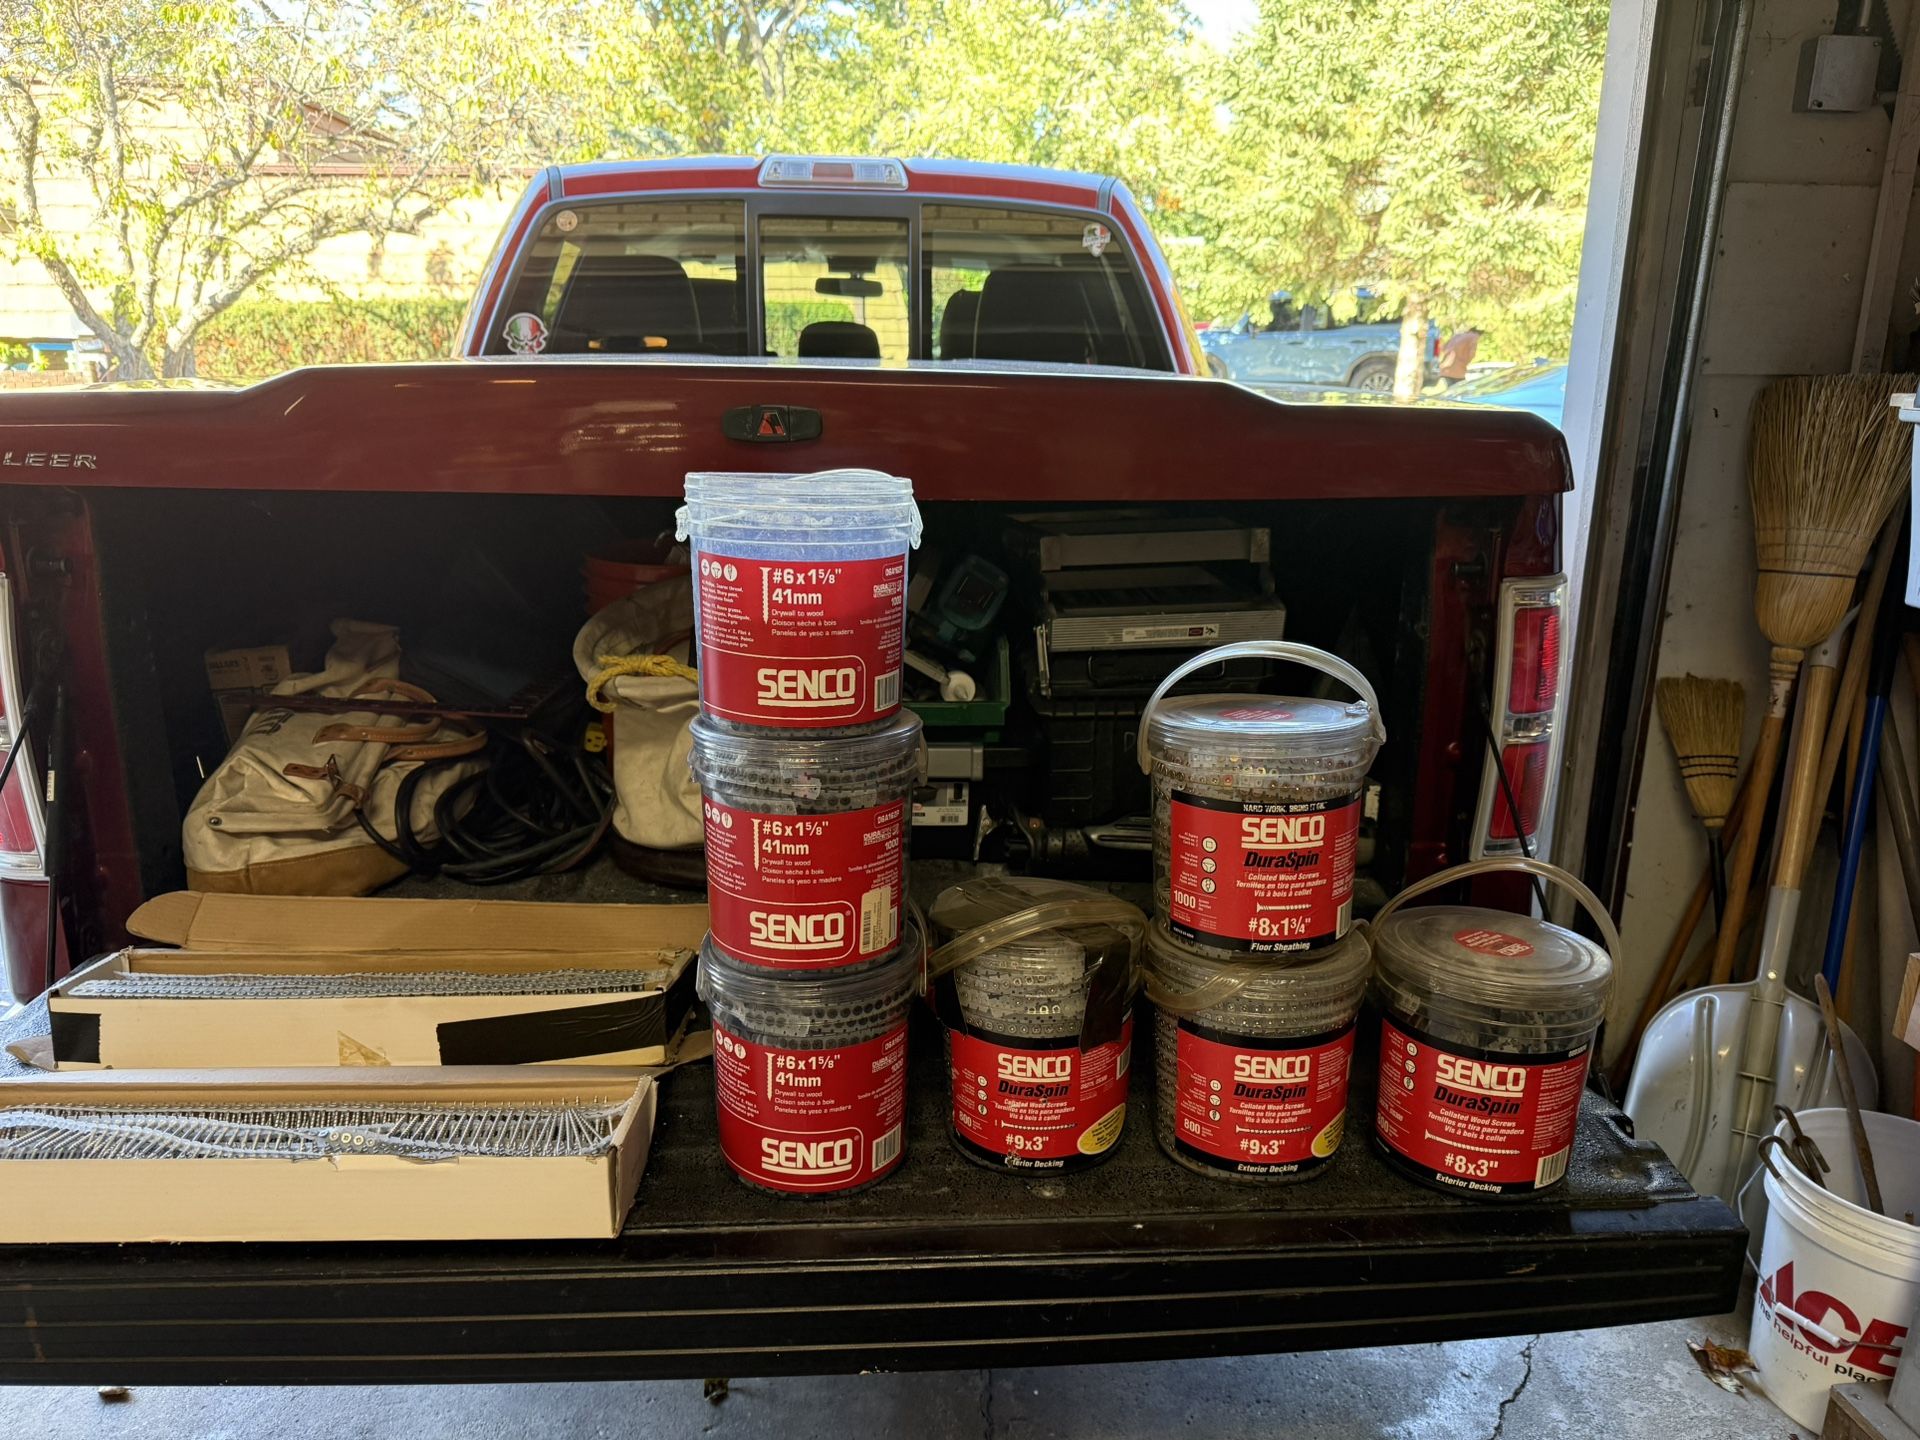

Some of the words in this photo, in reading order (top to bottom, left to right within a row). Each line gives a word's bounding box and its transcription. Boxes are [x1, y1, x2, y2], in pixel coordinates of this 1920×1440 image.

[3, 452, 97, 469] LEER
[772, 588, 823, 604] 41mm
[771, 609, 796, 617] Drywall
[771, 618, 795, 626] Cloison
[771, 629, 798, 637] Paneles
[757, 668, 856, 700] SENCO
[1241, 815, 1325, 844] SENCO
[762, 839, 810, 855] 41mm
[885, 837, 899, 851] 1000
[761, 857, 785, 866] Drywall
[1243, 851, 1320, 871] DuraSpin
[761, 866, 784, 875] Cloison
[1247, 872, 1278, 881] Collated
[1279, 873, 1297, 881] Wood
[1298, 872, 1320, 880] Screws
[761, 875, 786, 885] Paneles
[818, 876, 843, 884] madera
[1236, 880, 1266, 889] Tornillos
[1290, 882, 1305, 891] para
[1305, 879, 1327, 888] madera
[1173, 889, 1196, 909] 1000
[1254, 890, 1265, 898] Vis
[1266, 889, 1272, 897] à
[1272, 889, 1287, 898] bois
[1288, 889, 1294, 898] à
[1295, 888, 1313, 896] collet
[749, 911, 845, 943] SENCO
[1250, 942, 1273, 951] Floor
[1273, 941, 1311, 951] Sheathing
[997, 1053, 1072, 1078] SENCO
[1234, 1054, 1311, 1079] SENCO
[1436, 1053, 1527, 1092] SENCO
[775, 1071, 822, 1087] 41mm
[774, 1088, 797, 1098] Drywall
[998, 1080, 1070, 1099] DuraSpin
[1233, 1083, 1307, 1102] DuraSpin
[774, 1097, 796, 1105] Cloison
[994, 1101, 1019, 1113] Tornillos
[1028, 1107, 1039, 1115] tira
[1040, 1108, 1053, 1116] para
[1004, 1098, 1029, 1107] Collated
[1029, 1100, 1046, 1108] Wood
[1239, 1102, 1266, 1110] Collated
[1284, 1102, 1305, 1110] Screws
[1433, 1086, 1521, 1115] DuraSpin
[774, 1105, 798, 1114] Paneles
[829, 1104, 852, 1113] madera
[1024, 1113, 1038, 1121] bois
[1229, 1106, 1255, 1116] Tornillos
[1291, 1108, 1312, 1116] madera
[1439, 1107, 1470, 1121] Collated
[1470, 1115, 1491, 1125] Wood
[1491, 1119, 1517, 1127] Screws
[1184, 1118, 1201, 1135] 800
[1255, 1116, 1261, 1124] à
[1261, 1116, 1275, 1124] bois
[1275, 1116, 1280, 1124] à
[1280, 1116, 1298, 1124] collet
[1427, 1111, 1457, 1126] Tornillos
[1457, 1121, 1467, 1129] en
[1467, 1123, 1481, 1131] tira
[1481, 1126, 1498, 1134] para
[1499, 1127, 1526, 1135] madera
[1444, 1125, 1455, 1133] Vis
[1456, 1127, 1462, 1135] à
[1462, 1129, 1478, 1139] bois
[1479, 1131, 1485, 1140] à
[1485, 1134, 1507, 1142] collet
[1005, 1133, 1049, 1151] #9x3"
[1239, 1138, 1286, 1155] #9x3"
[761, 1137, 854, 1169] SENCO
[1034, 1160, 1064, 1168] Decking
[1237, 1163, 1268, 1172] Exterior
[1269, 1164, 1299, 1172] Decking
[1445, 1153, 1499, 1177] #8x3"
[1435, 1173, 1469, 1188] Exterior
[1469, 1181, 1503, 1193] Decking
[1759, 1260, 1909, 1378] ACE
[1773, 1318, 1830, 1366] helpful
[1834, 1363, 1879, 1383] plac
